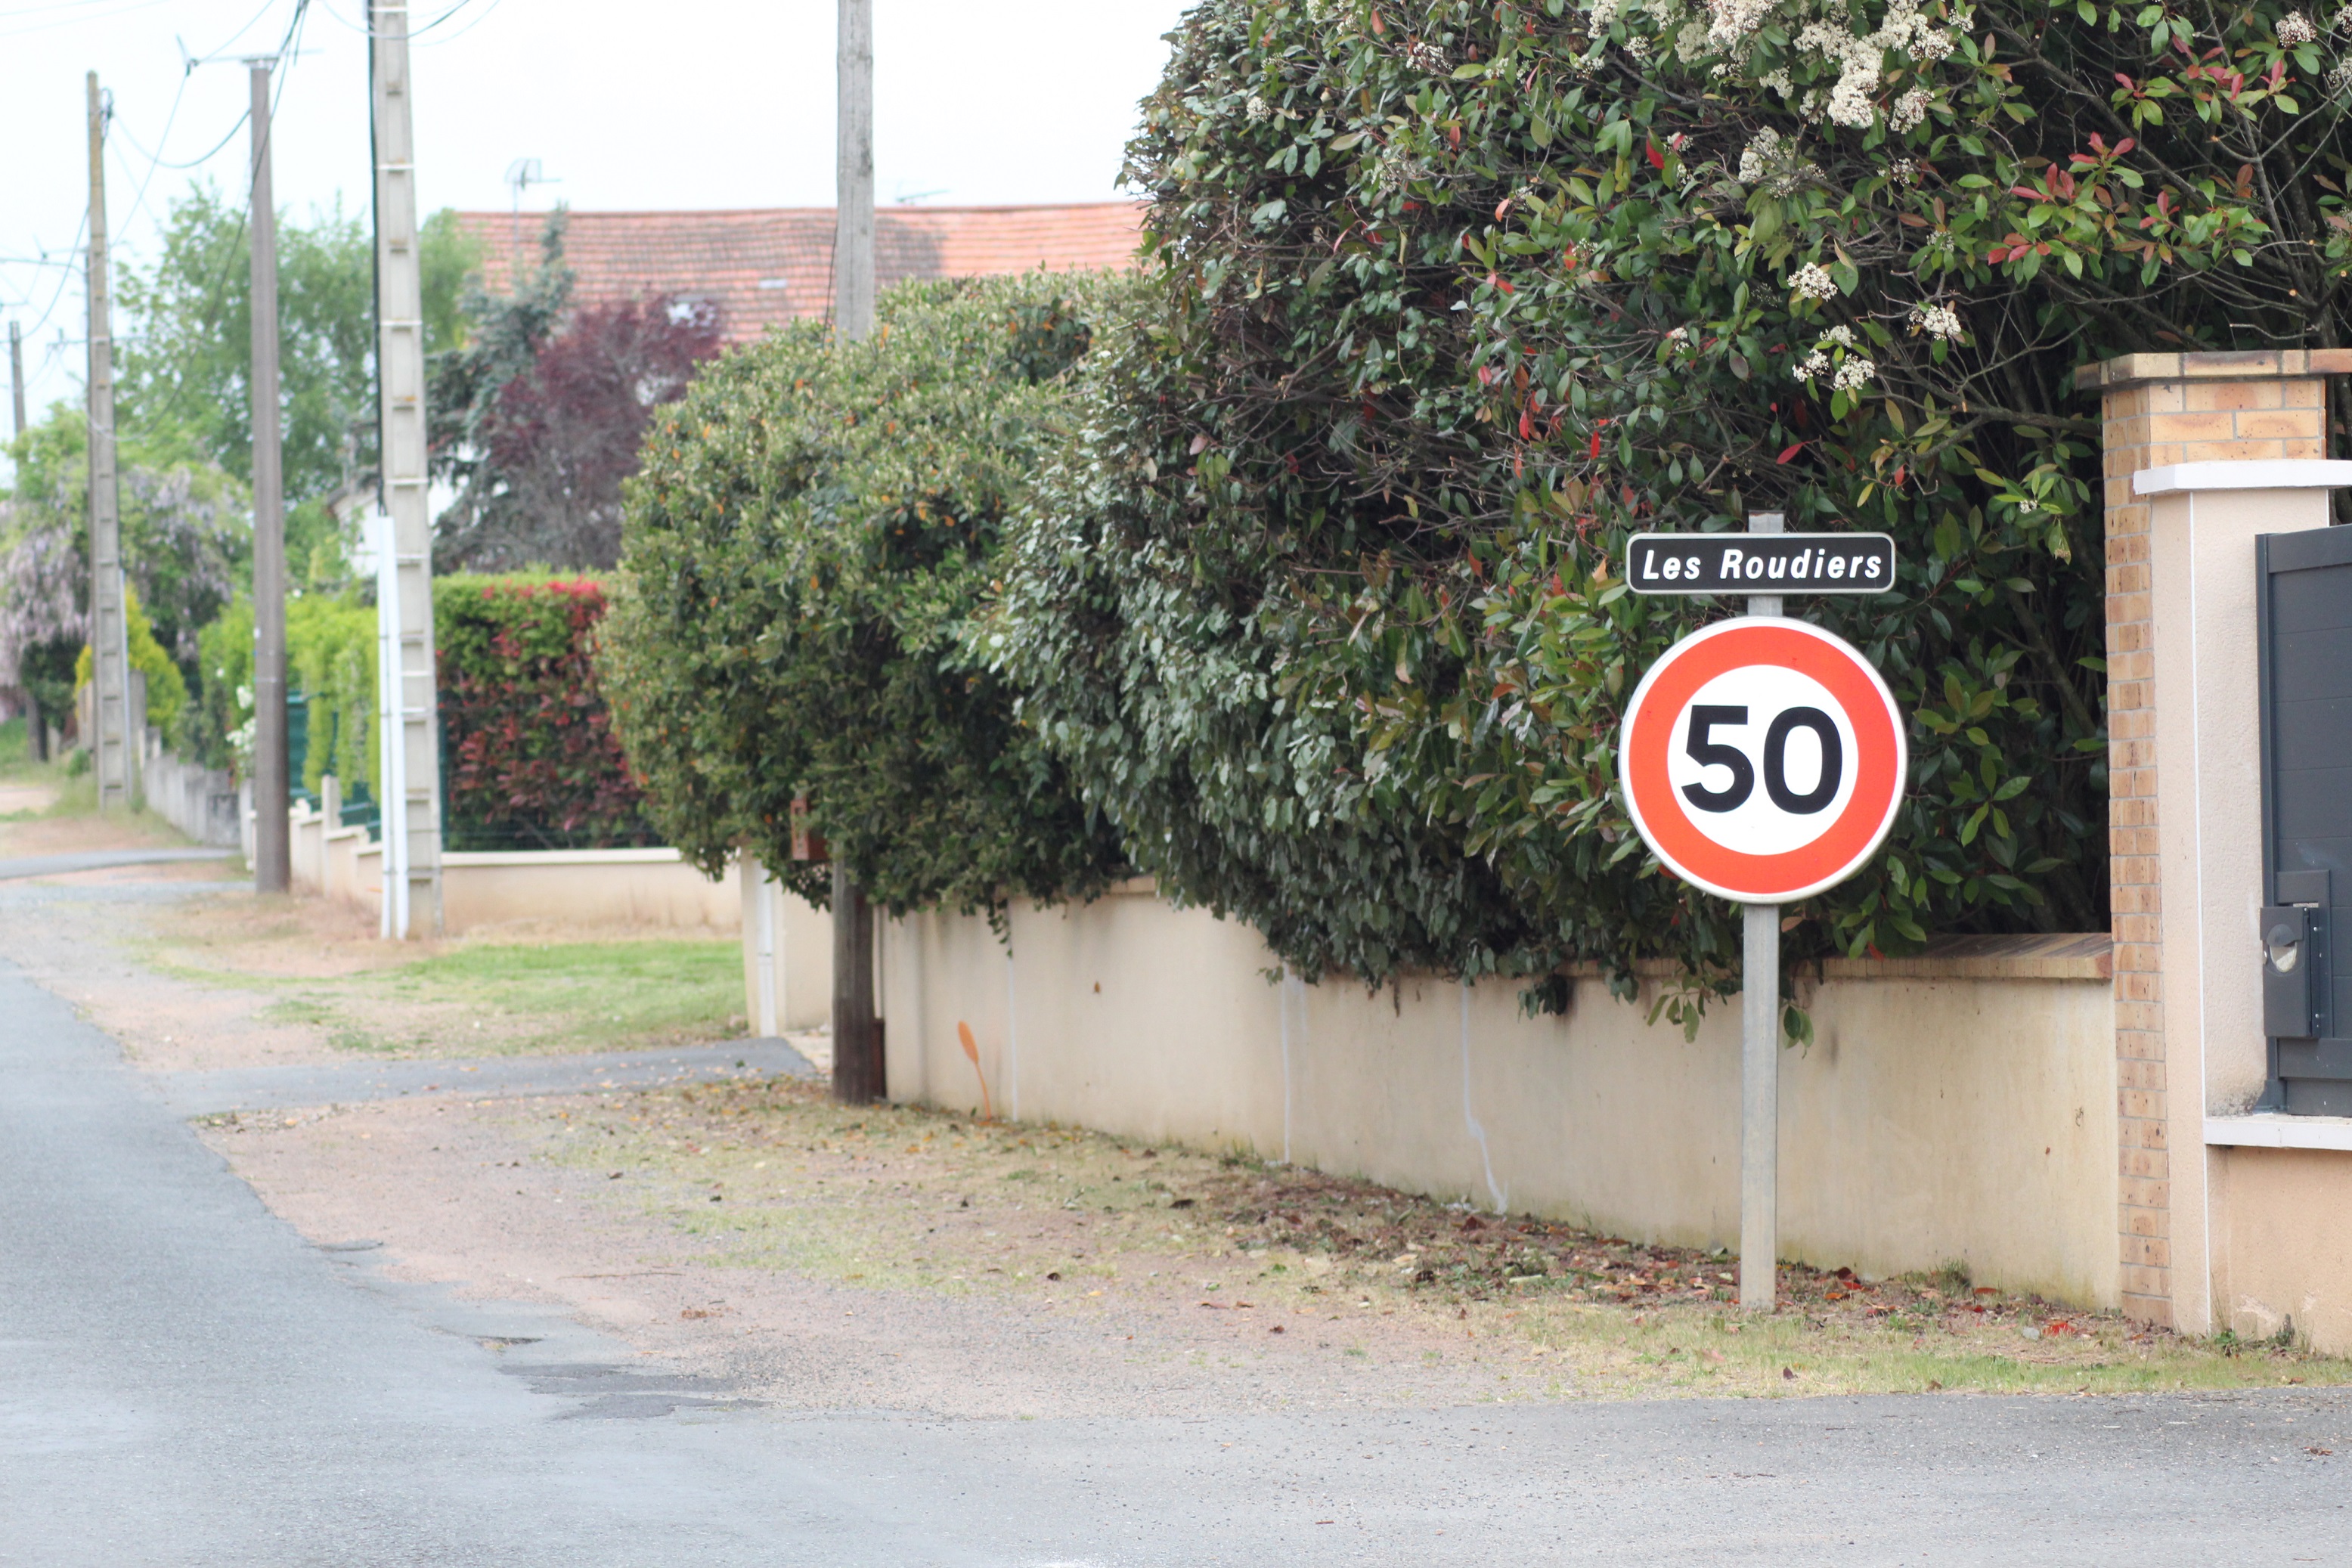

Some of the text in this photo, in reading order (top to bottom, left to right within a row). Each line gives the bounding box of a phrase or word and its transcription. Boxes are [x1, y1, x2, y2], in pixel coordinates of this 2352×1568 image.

[1642, 548, 1882, 580] Les Roudiers
[1681, 705, 1842, 814] 50
